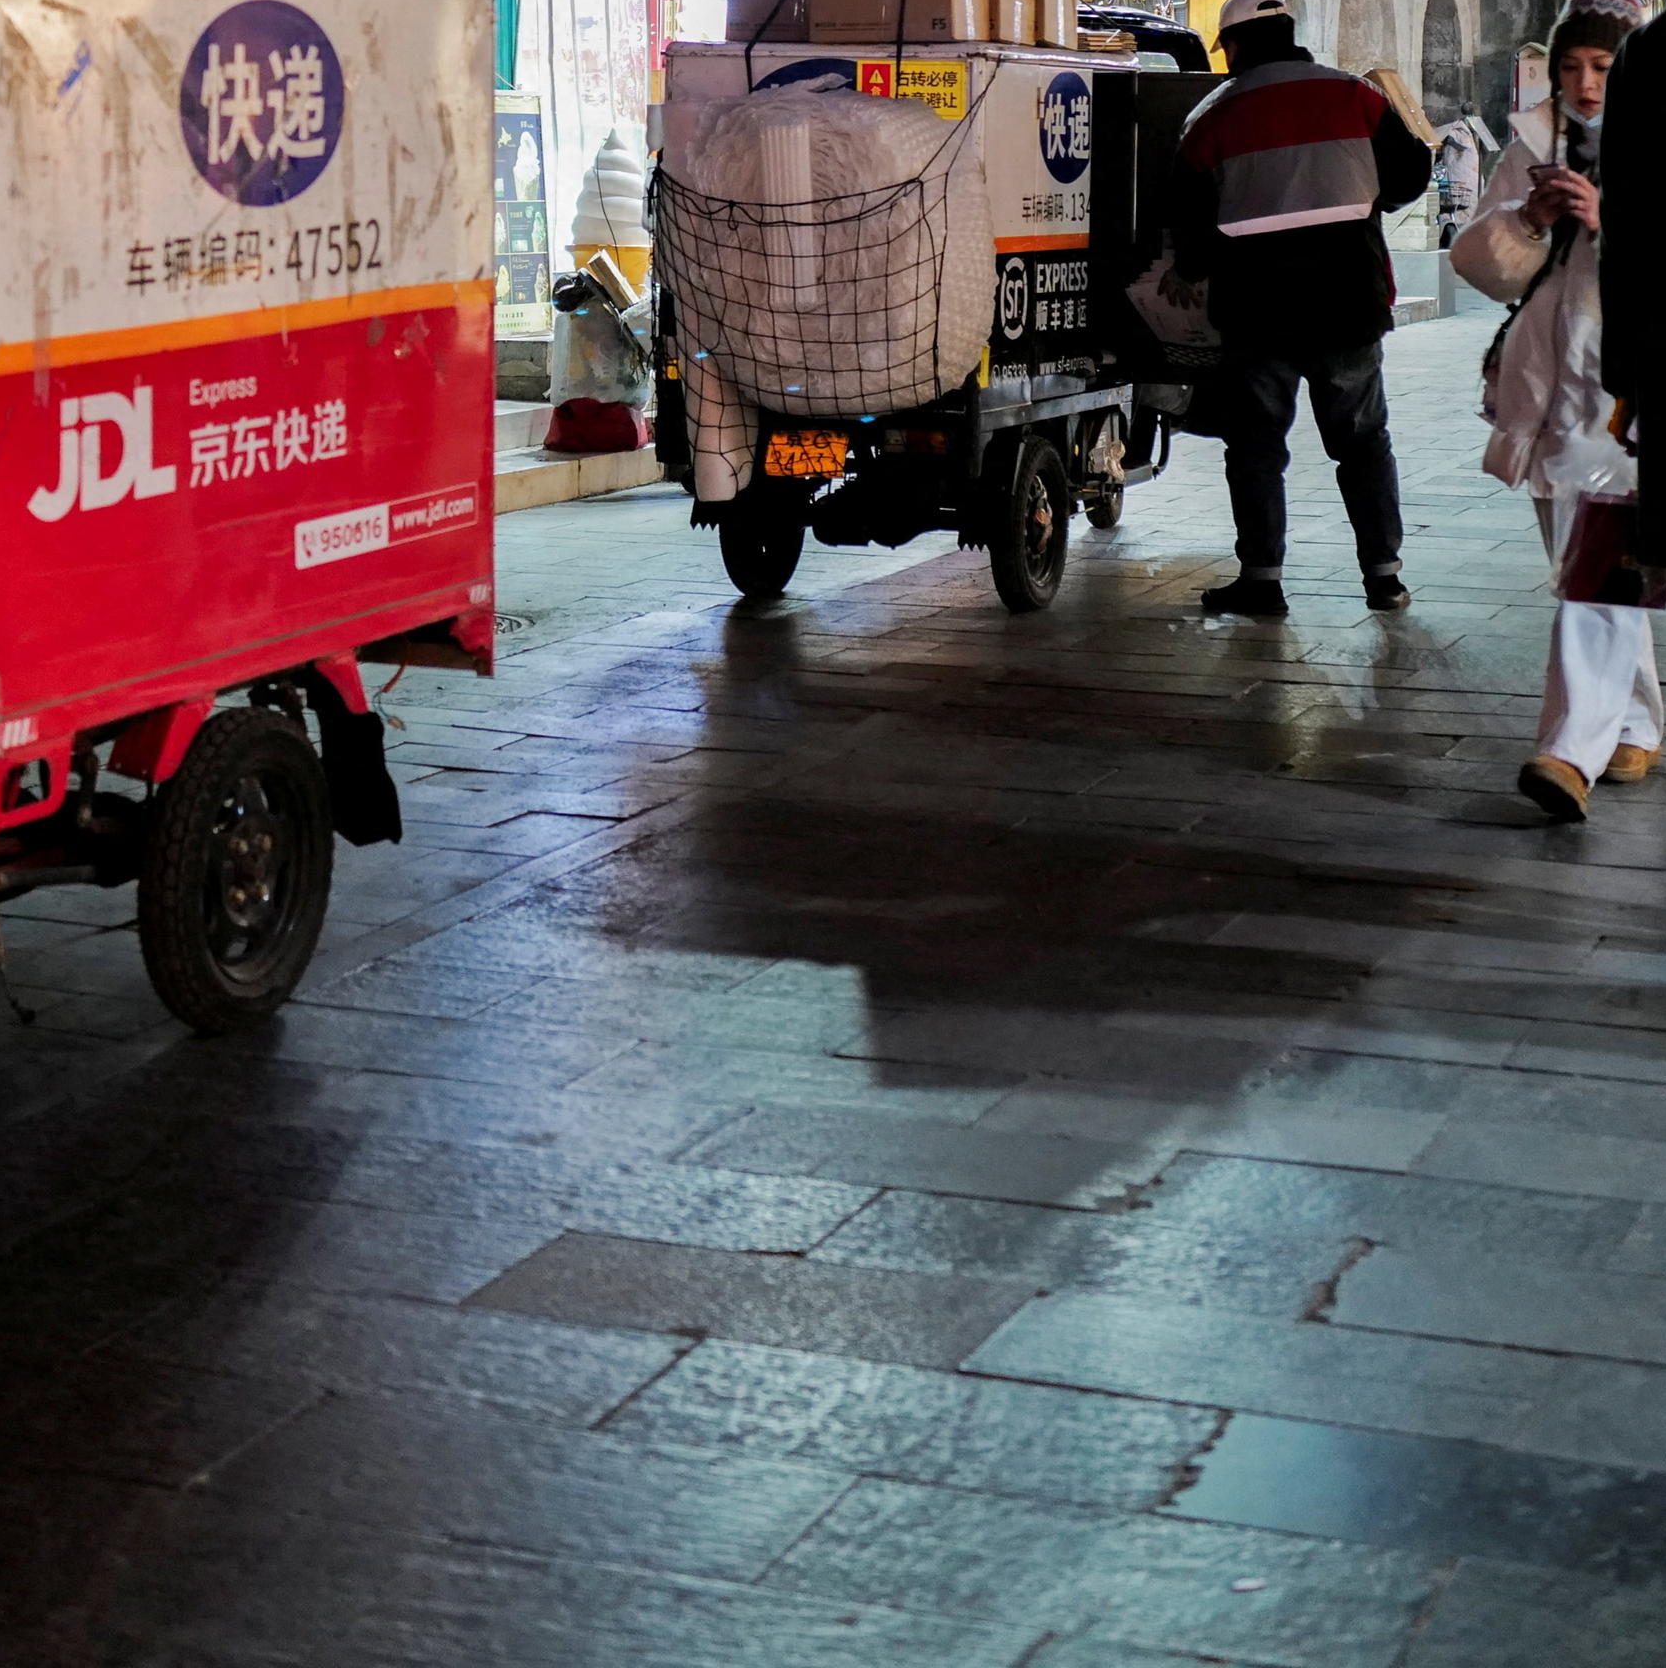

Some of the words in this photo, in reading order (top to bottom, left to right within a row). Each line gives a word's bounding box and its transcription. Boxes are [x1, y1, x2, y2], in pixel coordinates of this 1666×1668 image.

[897, 70, 958, 88] 右转必停
[200, 40, 327, 165] 快递
[1039, 92, 1090, 160] 快递
[1036, 261, 1089, 294] EXPRESS
[1035, 297, 1088, 332] 顺丰速运
[189, 376, 258, 408] Express
[26, 384, 177, 523] JDL
[189, 399, 348, 489] 京东快递
[392, 493, 475, 534] www.jdl.com
[319, 519, 384, 554] 950616
